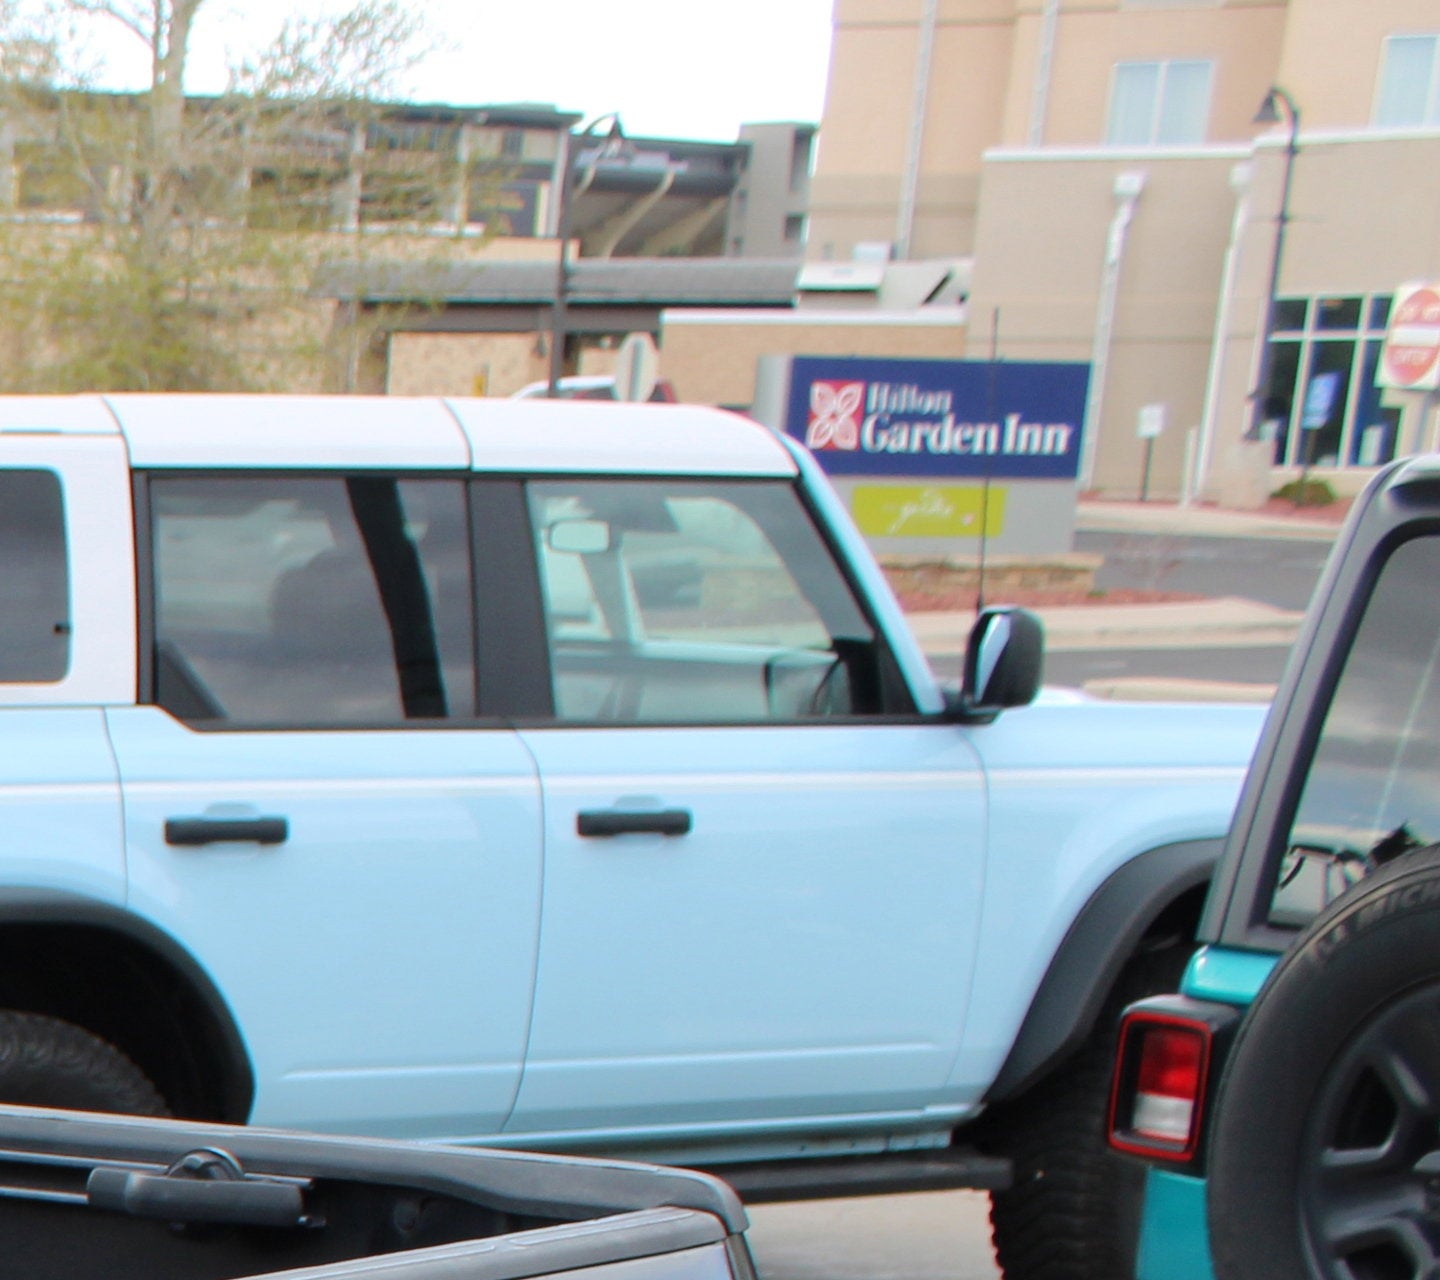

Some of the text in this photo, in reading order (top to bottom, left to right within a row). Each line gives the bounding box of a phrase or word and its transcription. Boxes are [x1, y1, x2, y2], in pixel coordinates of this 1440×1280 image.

[867, 382, 953, 414] Hilton
[861, 412, 1073, 455] Garden Inn
